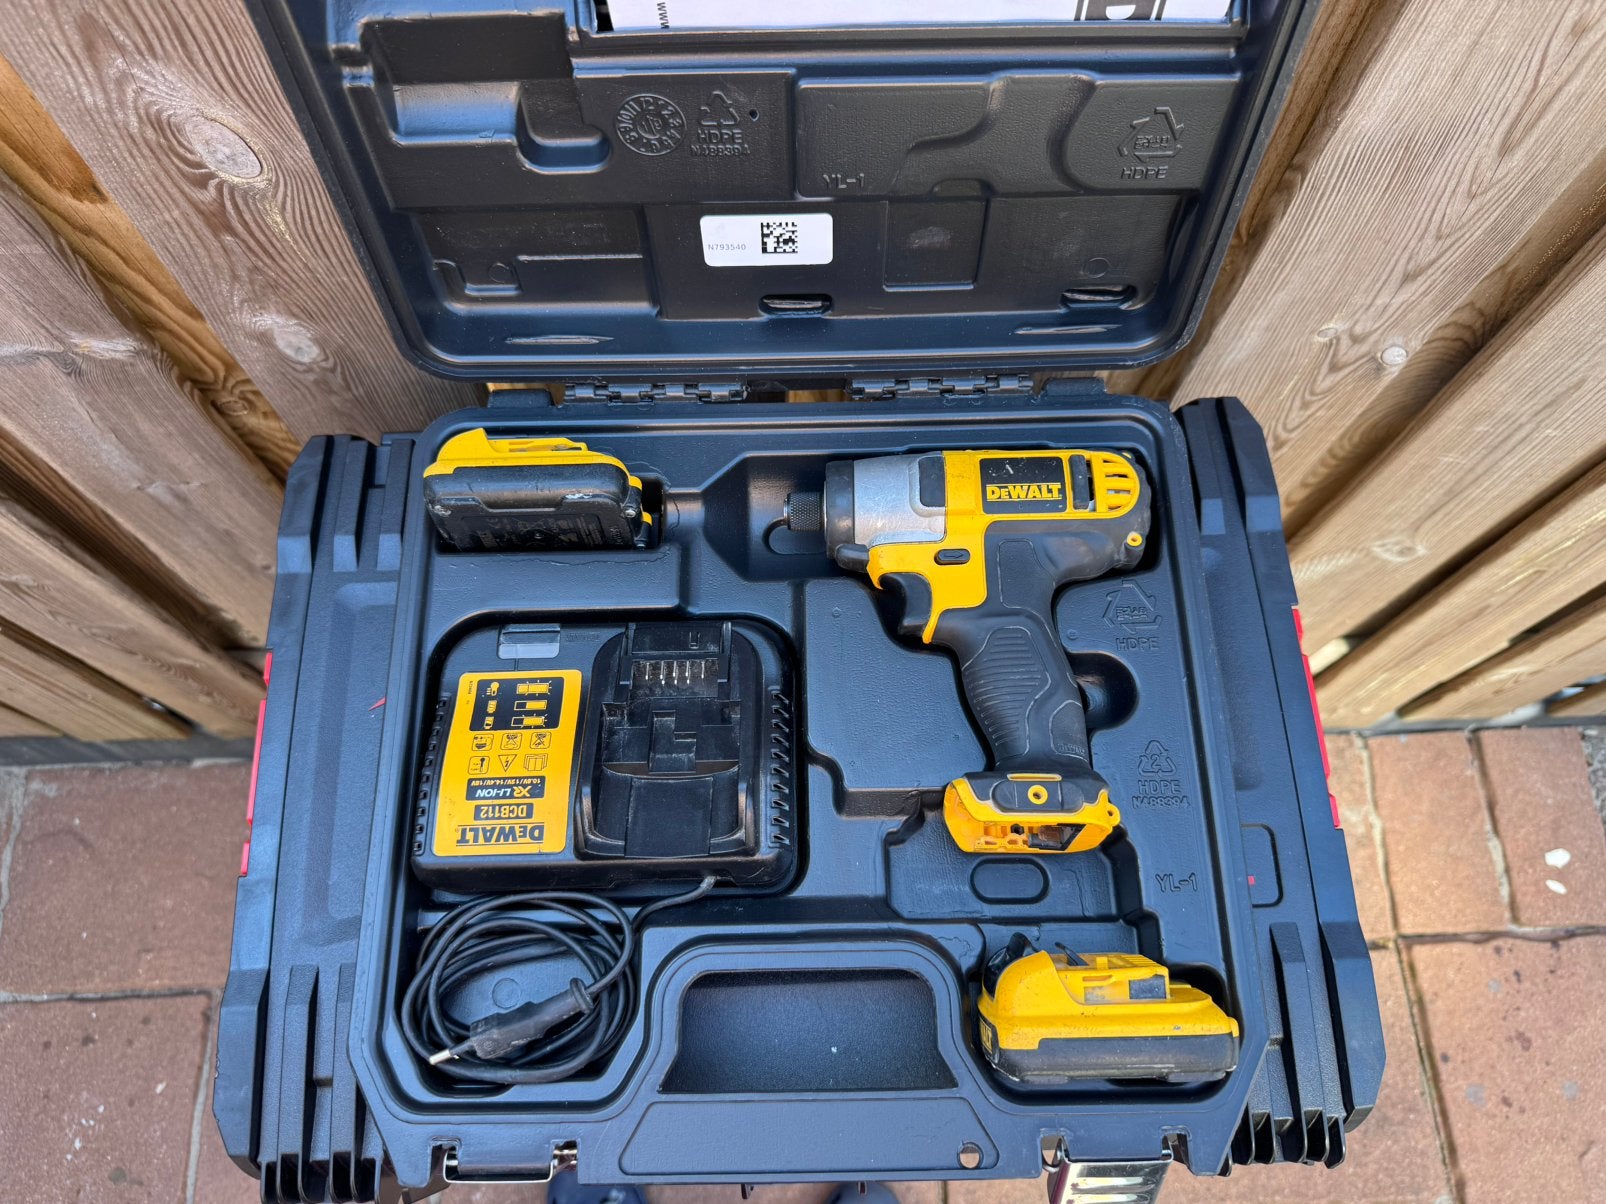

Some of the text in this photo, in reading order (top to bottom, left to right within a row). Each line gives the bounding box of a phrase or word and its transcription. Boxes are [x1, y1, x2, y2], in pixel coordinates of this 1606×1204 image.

[697, 128, 743, 143] HDPE
[1121, 165, 1169, 179] HDPE
[708, 243, 746, 251] N793540
[1115, 636, 1160, 652] HDPE
[475, 785, 532, 797] XR LI-ION
[1137, 779, 1182, 795] HDPE
[480, 806, 526, 818] DCB112
[1155, 872, 1198, 892] YL-1
